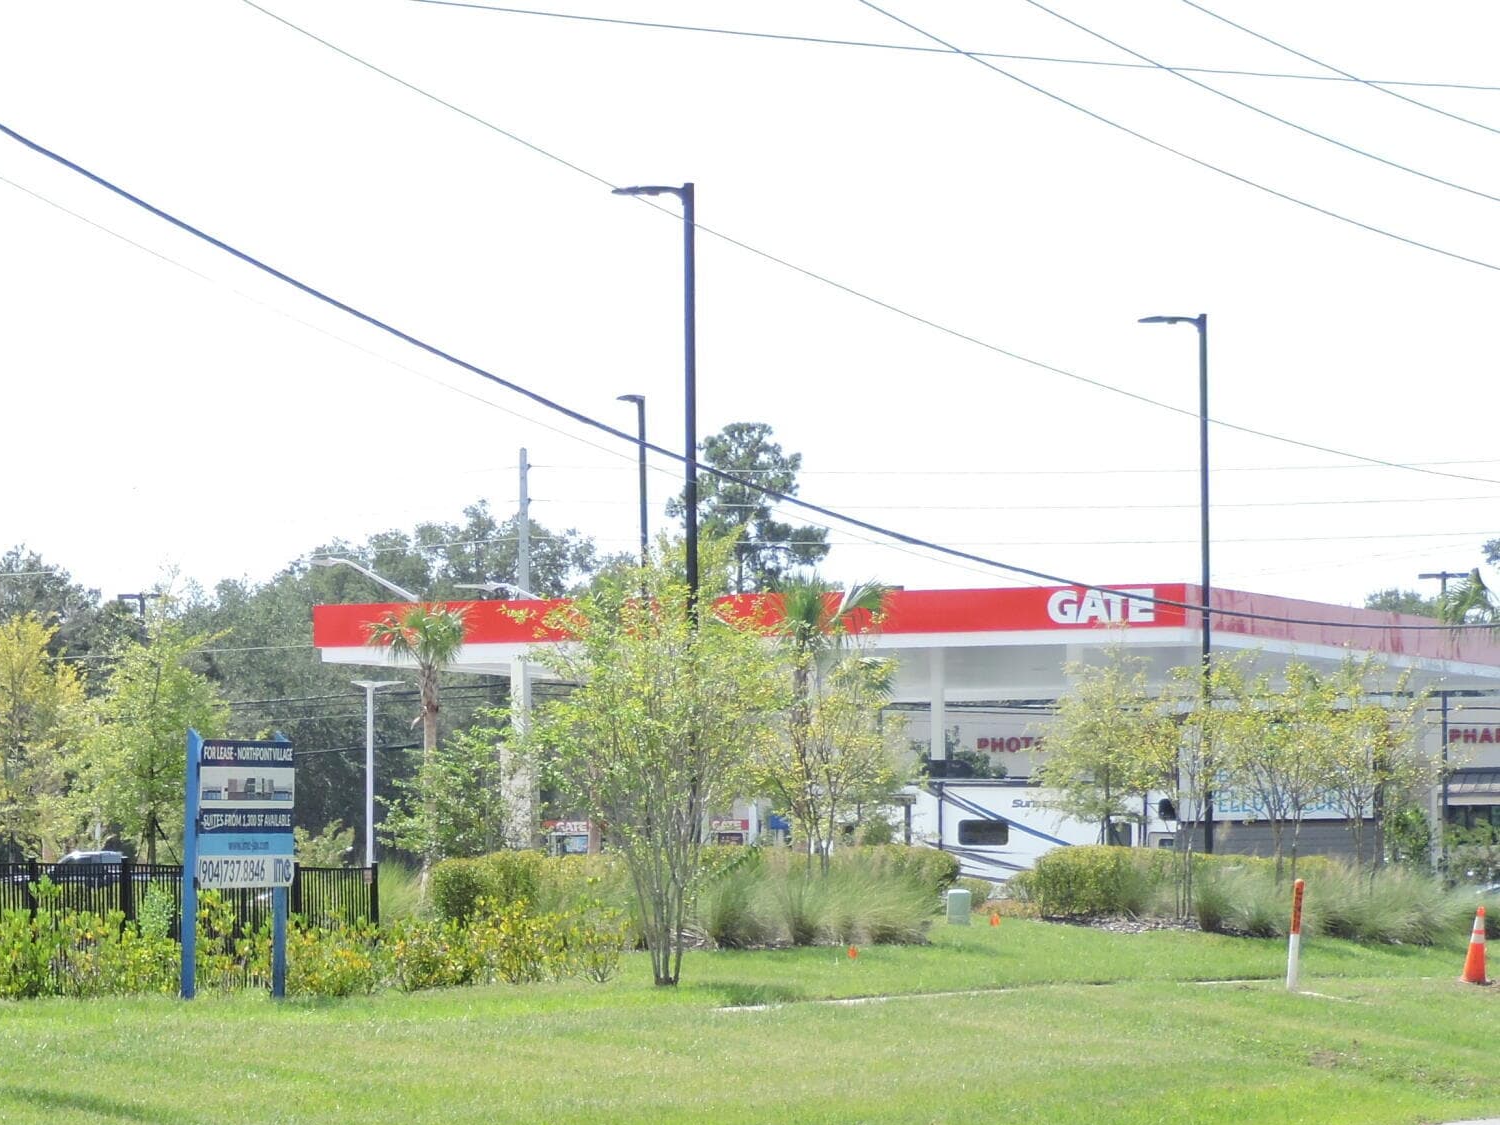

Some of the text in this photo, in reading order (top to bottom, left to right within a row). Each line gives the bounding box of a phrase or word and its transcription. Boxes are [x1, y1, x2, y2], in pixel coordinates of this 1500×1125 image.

[1047, 588, 1155, 624] GATE
[203, 746, 216, 760] FOR
[217, 746, 234, 760] LEASE
[202, 814, 224, 828] SUITES
[224, 814, 242, 827] FROM
[264, 814, 291, 827] AVAILABLE
